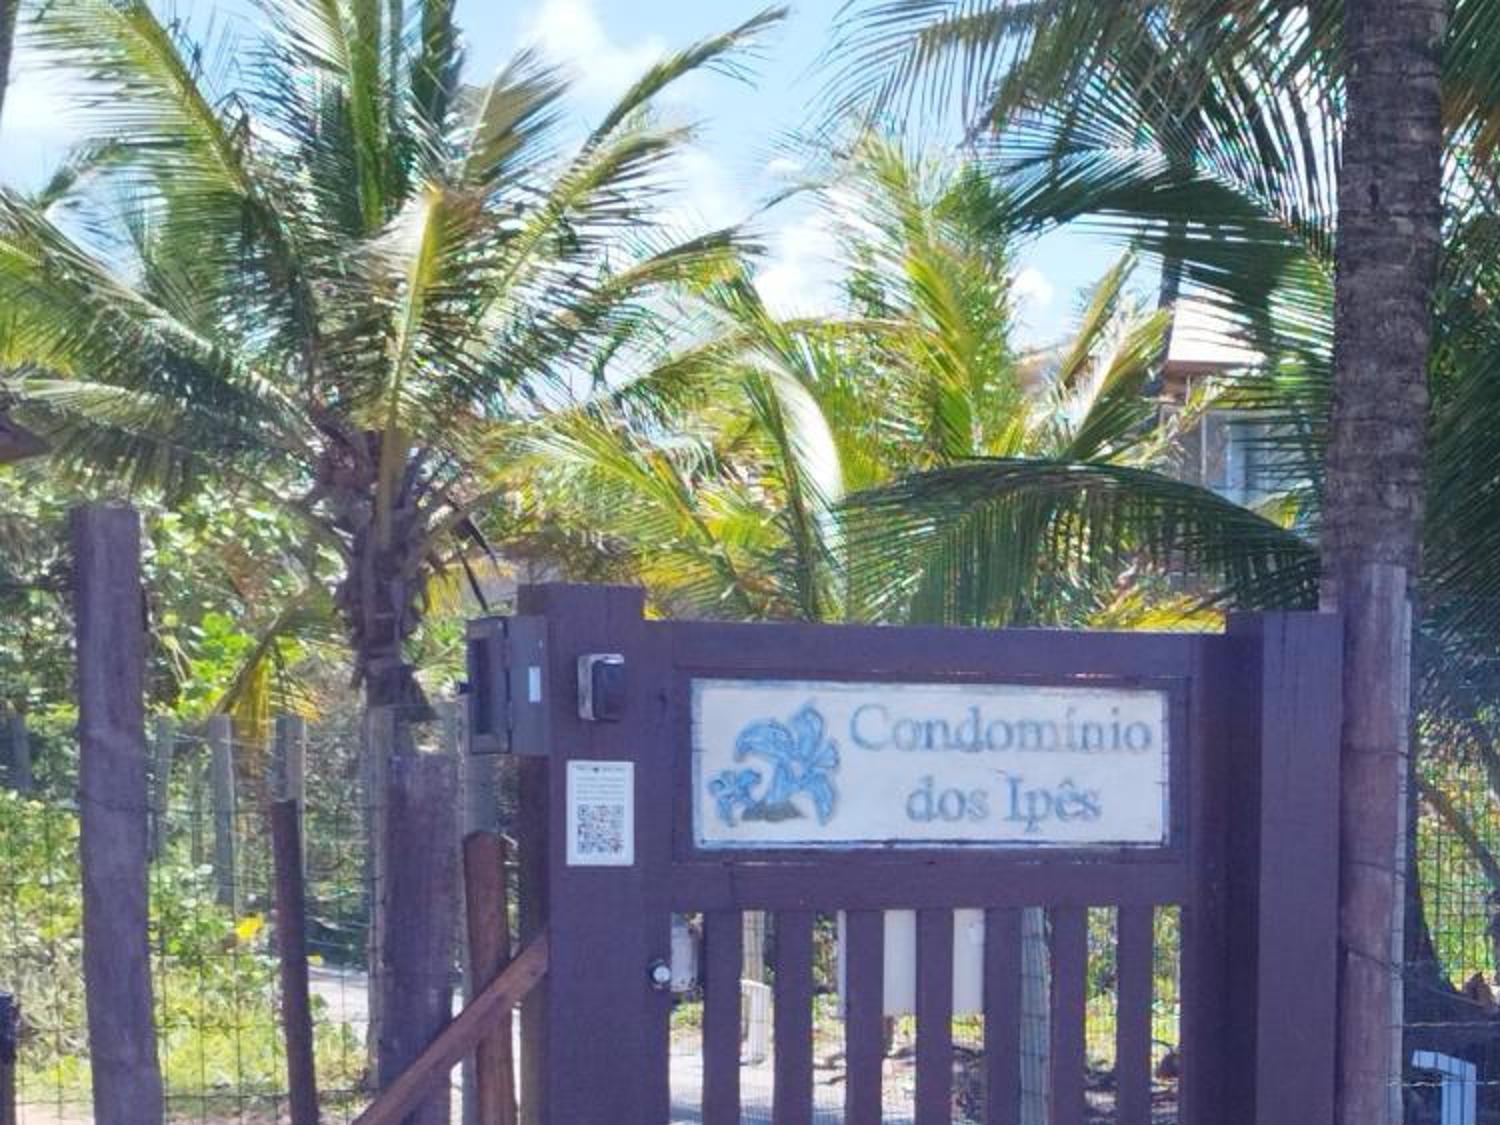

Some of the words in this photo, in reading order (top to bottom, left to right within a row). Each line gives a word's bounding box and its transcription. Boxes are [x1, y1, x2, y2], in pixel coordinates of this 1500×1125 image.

[849, 703, 1152, 752] Condomínio
[905, 774, 988, 823] dos
[1003, 776, 1102, 833] Ipês
